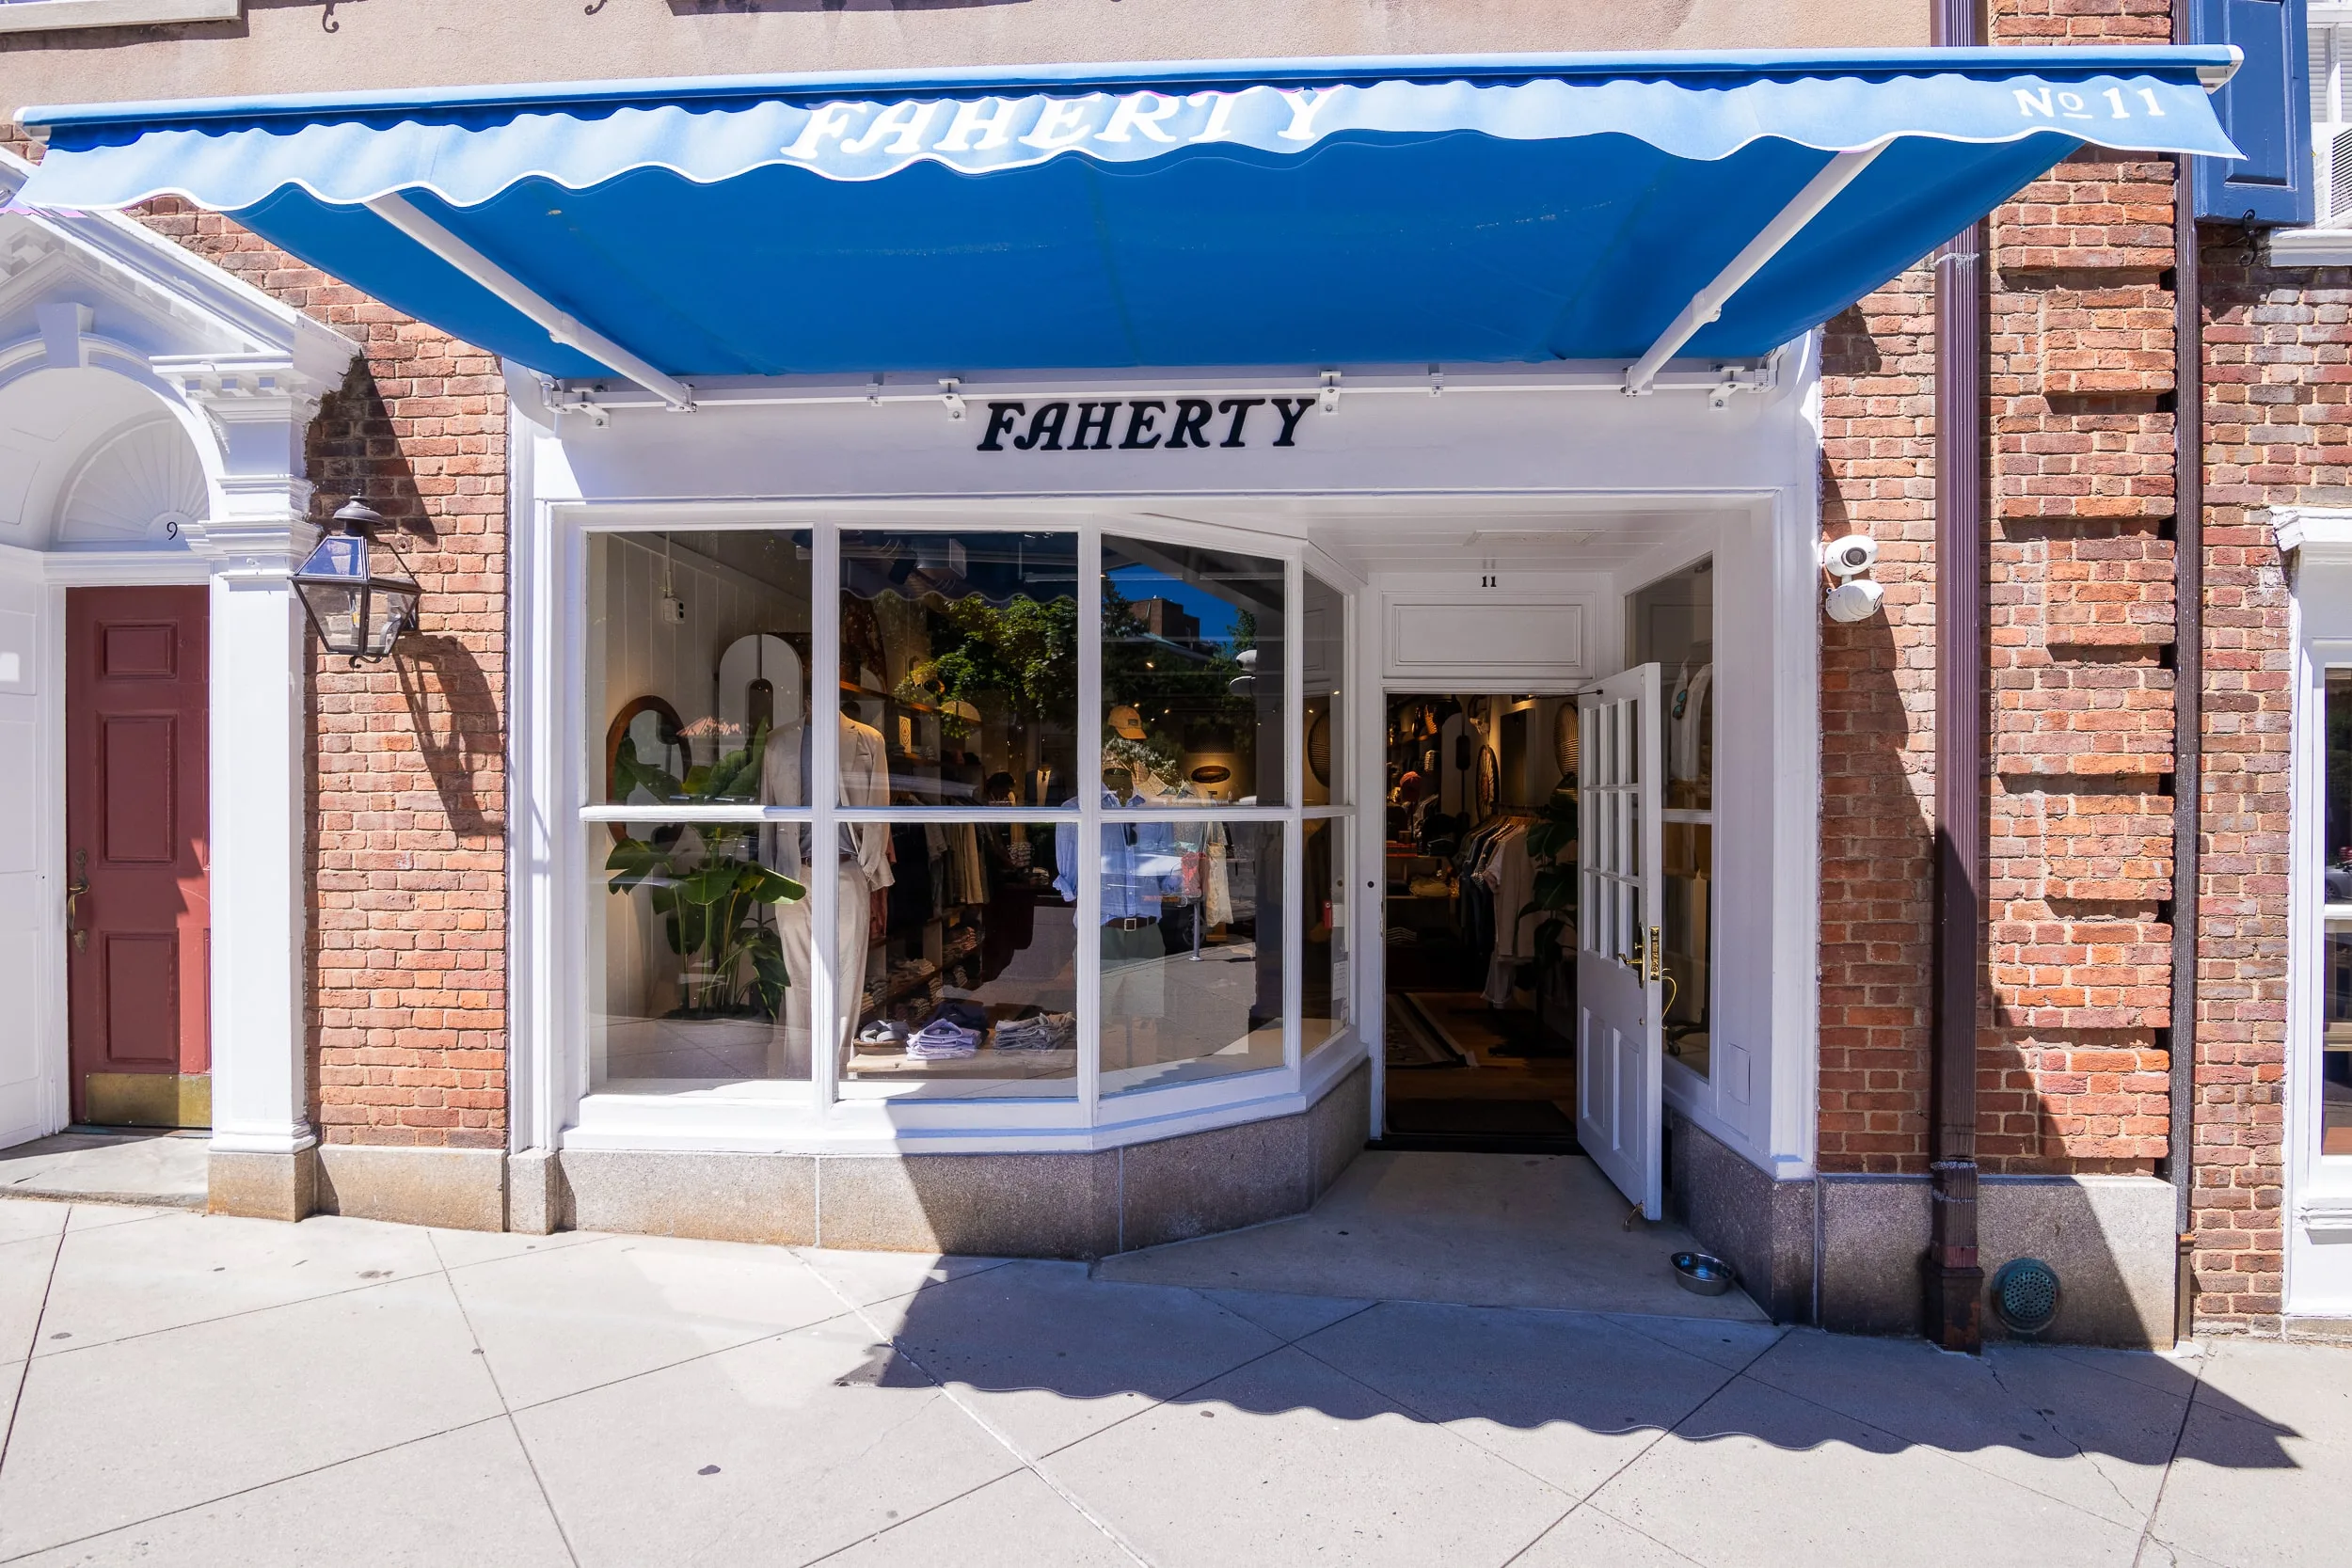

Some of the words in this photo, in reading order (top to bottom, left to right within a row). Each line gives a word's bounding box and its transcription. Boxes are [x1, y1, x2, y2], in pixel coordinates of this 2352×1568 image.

[2102, 87, 2166, 119] 11
[780, 84, 1343, 159] FAHERTY
[977, 398, 1316, 451] FAHERTY
[167, 521, 178, 541] 9
[1481, 575, 1497, 588] 11
